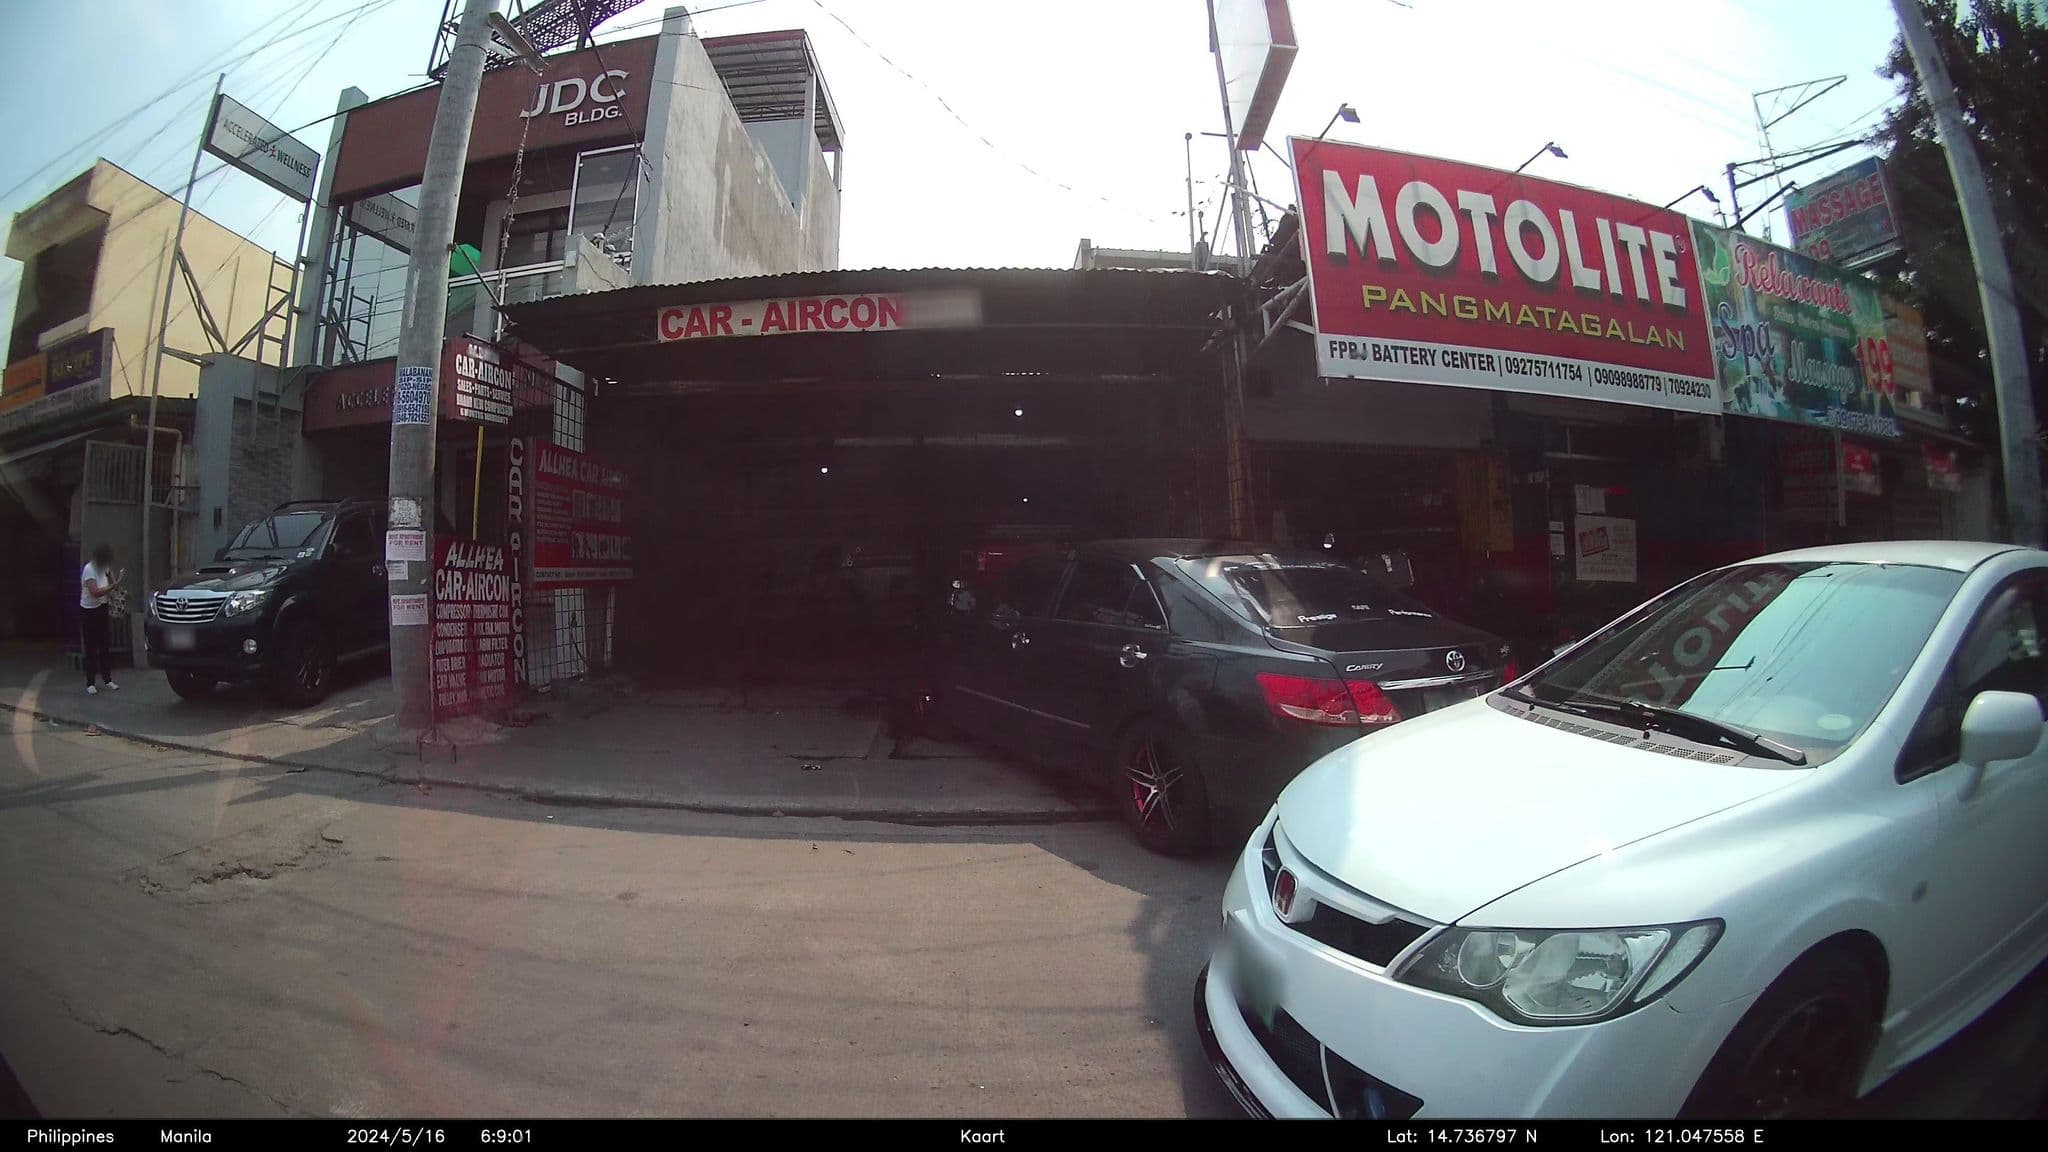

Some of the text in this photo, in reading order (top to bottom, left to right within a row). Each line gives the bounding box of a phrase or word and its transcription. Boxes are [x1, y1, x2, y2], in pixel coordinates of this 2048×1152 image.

[520, 69, 629, 118] JDC
[564, 105, 623, 127] BLDG.
[223, 117, 312, 179] ACCELERATED WELLNESS
[1791, 172, 1887, 237] MASSAGE
[1322, 168, 1687, 308] MOTOLITE
[661, 304, 733, 340] CAR
[760, 297, 904, 333] AIRCON
[1361, 283, 1686, 352] PANGMATAGALAN
[1717, 301, 1775, 378] Spa
[456, 353, 512, 391] CAR-AIRCON
[1372, 343, 1437, 367] BATTERY
[1441, 349, 1496, 372] CENTER
[1505, 356, 1583, 381] 09275711754
[1850, 335, 1896, 396] 199
[538, 449, 578, 479] ALLHEA
[444, 541, 504, 572] ALLHEA
[507, 437, 527, 685] CAR AIRCON
[435, 568, 510, 601] CAR-AIRCON
[480, 652, 505, 668] ADIATOR
[1345, 662, 1384, 673] CAMRY
